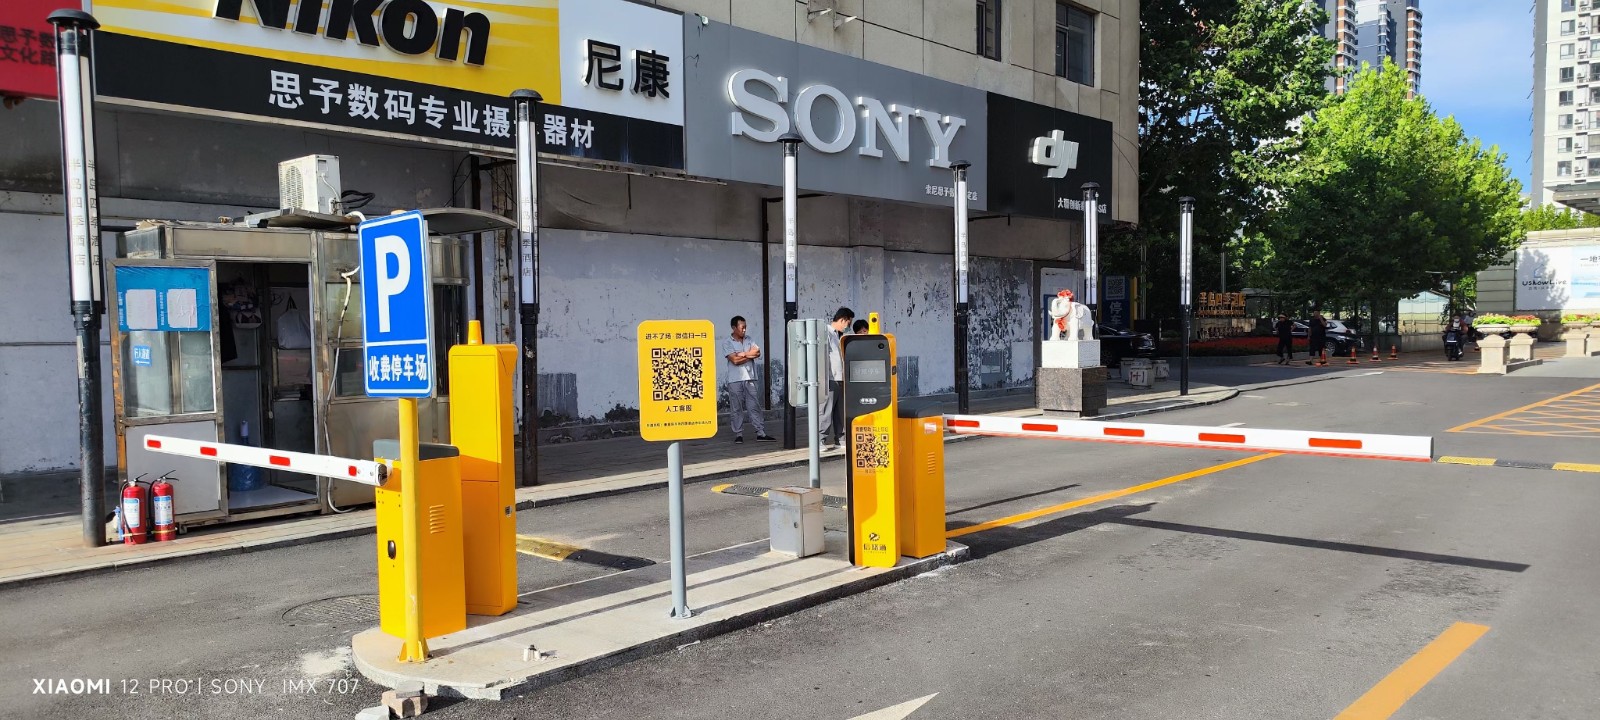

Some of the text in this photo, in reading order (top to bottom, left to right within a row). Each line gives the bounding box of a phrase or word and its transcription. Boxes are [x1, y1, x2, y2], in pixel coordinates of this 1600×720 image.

[580, 38, 670, 99] 尼康
[268, 69, 595, 149] 思予数码专业摄器材
[728, 69, 967, 169] SONY
[374, 234, 411, 333] P
[369, 353, 428, 382] 收费停车场
